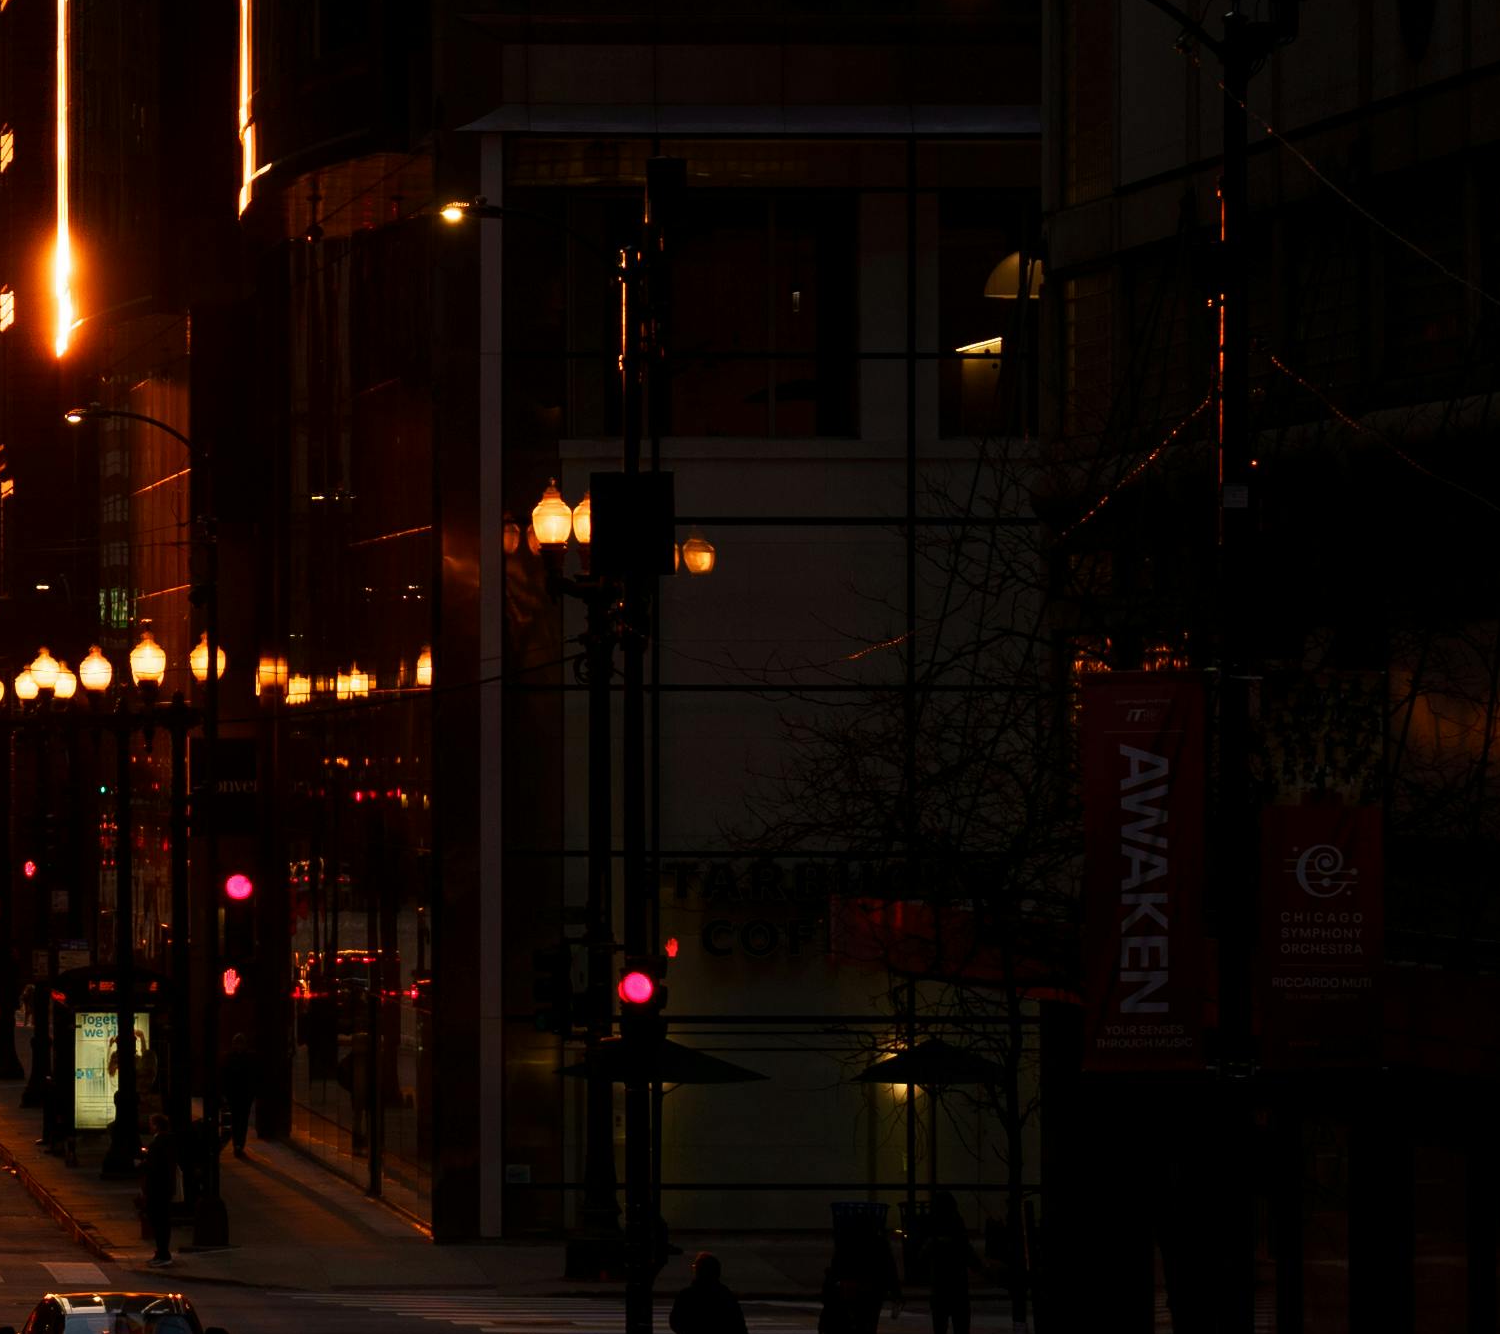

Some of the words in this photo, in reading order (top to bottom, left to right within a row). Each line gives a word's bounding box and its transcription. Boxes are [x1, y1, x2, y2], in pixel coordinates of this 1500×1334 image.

[1118, 743, 1170, 1013] AWAKEN
[1279, 911, 1364, 924] CHICAGO
[1279, 927, 1363, 939] SYMPHONY
[1279, 943, 1364, 955] ORCHESTRA
[1271, 976, 1340, 988] RICCARDO
[1342, 976, 1372, 988] MUTI
[1104, 1024, 1137, 1036] YOUR
[1139, 1024, 1185, 1036] SENSES
[1096, 1037, 1153, 1049] THROUGH
[1154, 1036, 1192, 1049] MUSIC
